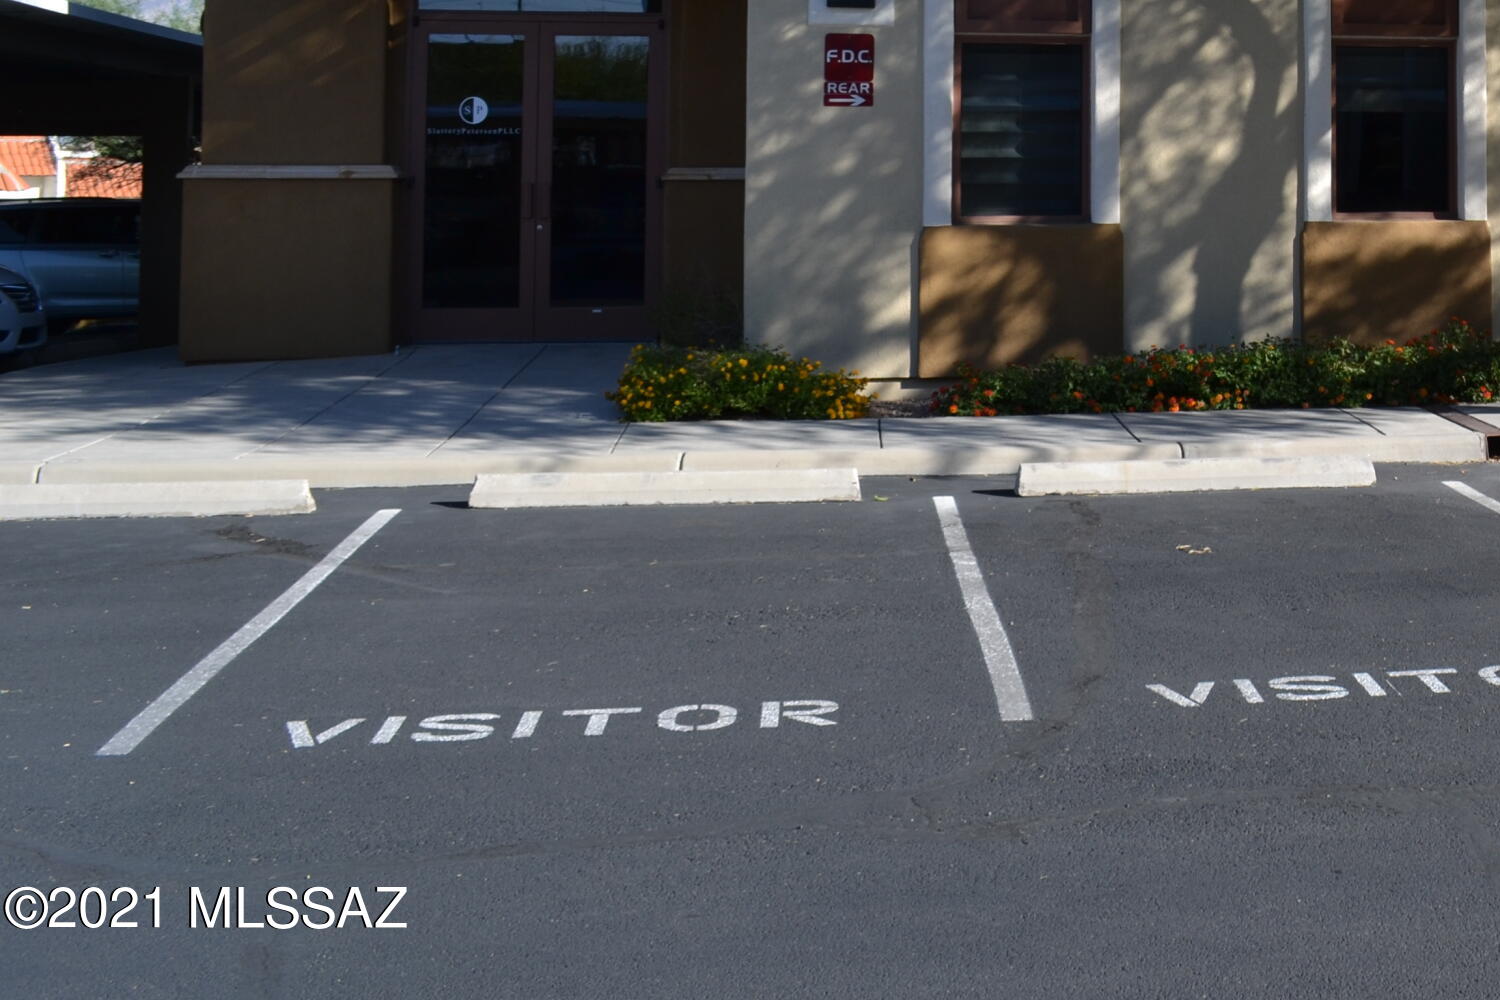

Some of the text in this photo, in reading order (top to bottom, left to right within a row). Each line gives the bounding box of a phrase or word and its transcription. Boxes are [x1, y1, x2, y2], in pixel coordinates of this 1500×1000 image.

[826, 49, 873, 63] F.D.C.
[827, 82, 870, 94] REAR
[286, 700, 839, 748] VISITOR
